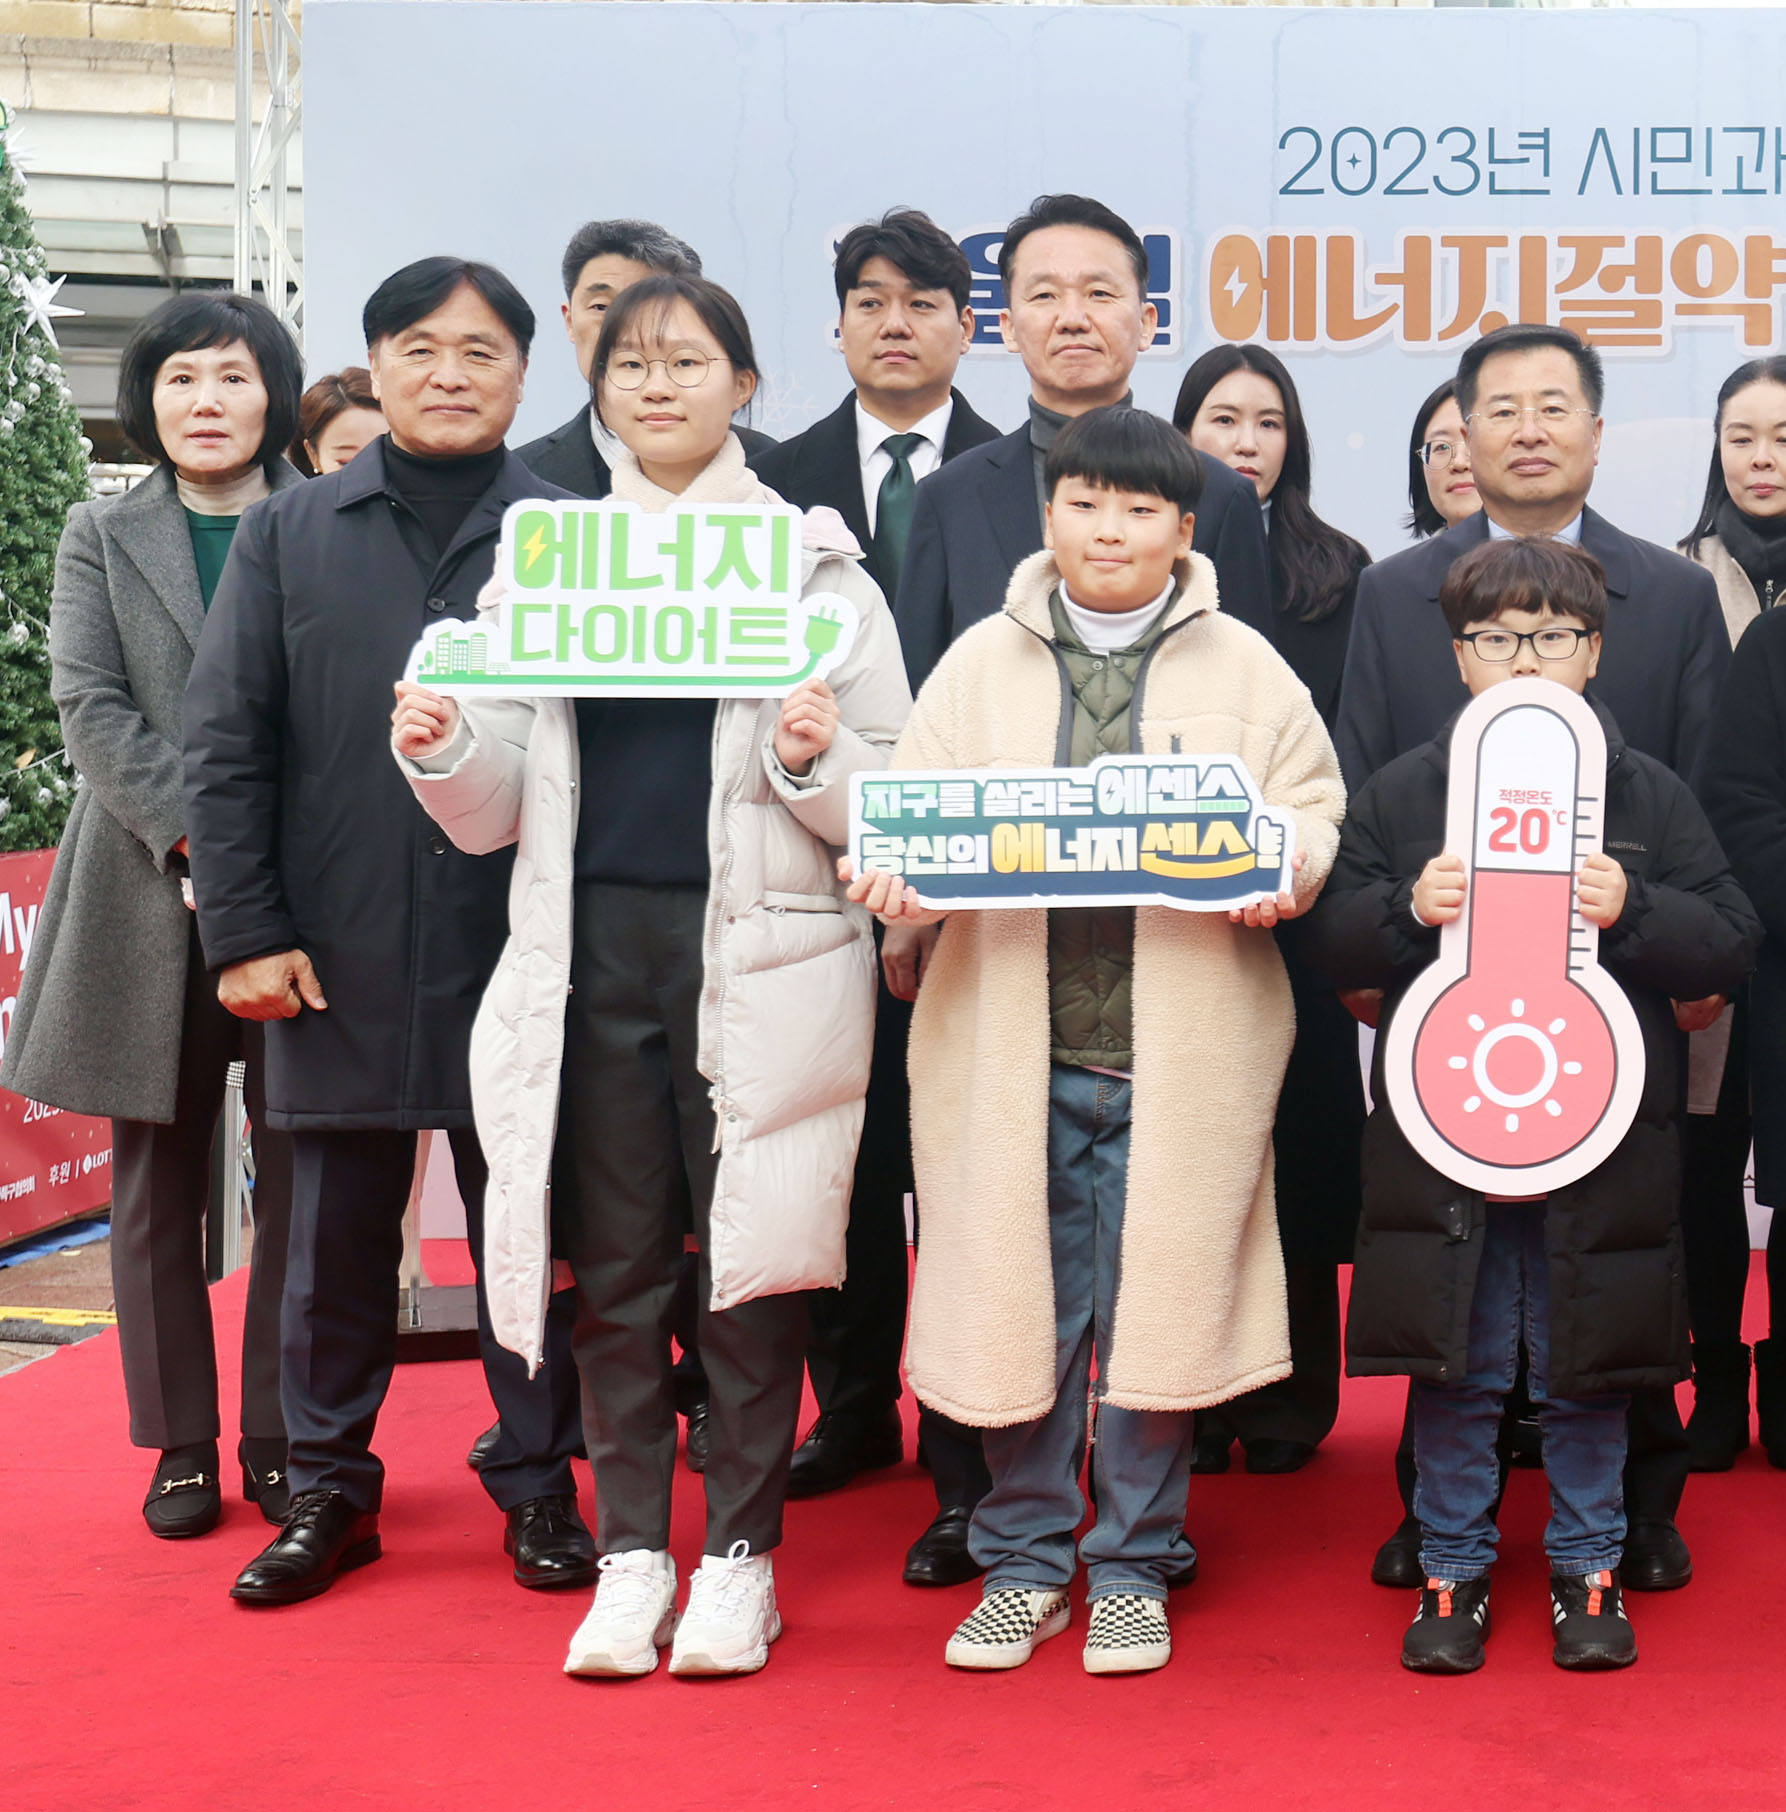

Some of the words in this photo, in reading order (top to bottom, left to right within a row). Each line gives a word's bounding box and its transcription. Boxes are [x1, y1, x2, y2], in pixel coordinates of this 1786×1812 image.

[1278, 126, 1551, 196] 2023년
[513, 510, 790, 594] 에너지
[510, 603, 791, 666] 다이어트
[863, 781, 976, 819] 지구를
[981, 780, 1094, 818] 살리는
[1499, 788, 1553, 806] 적정온도
[861, 834, 990, 876] 당신의
[991, 822, 1139, 874] 에너지
[48, 1160, 71, 1188] 후원
